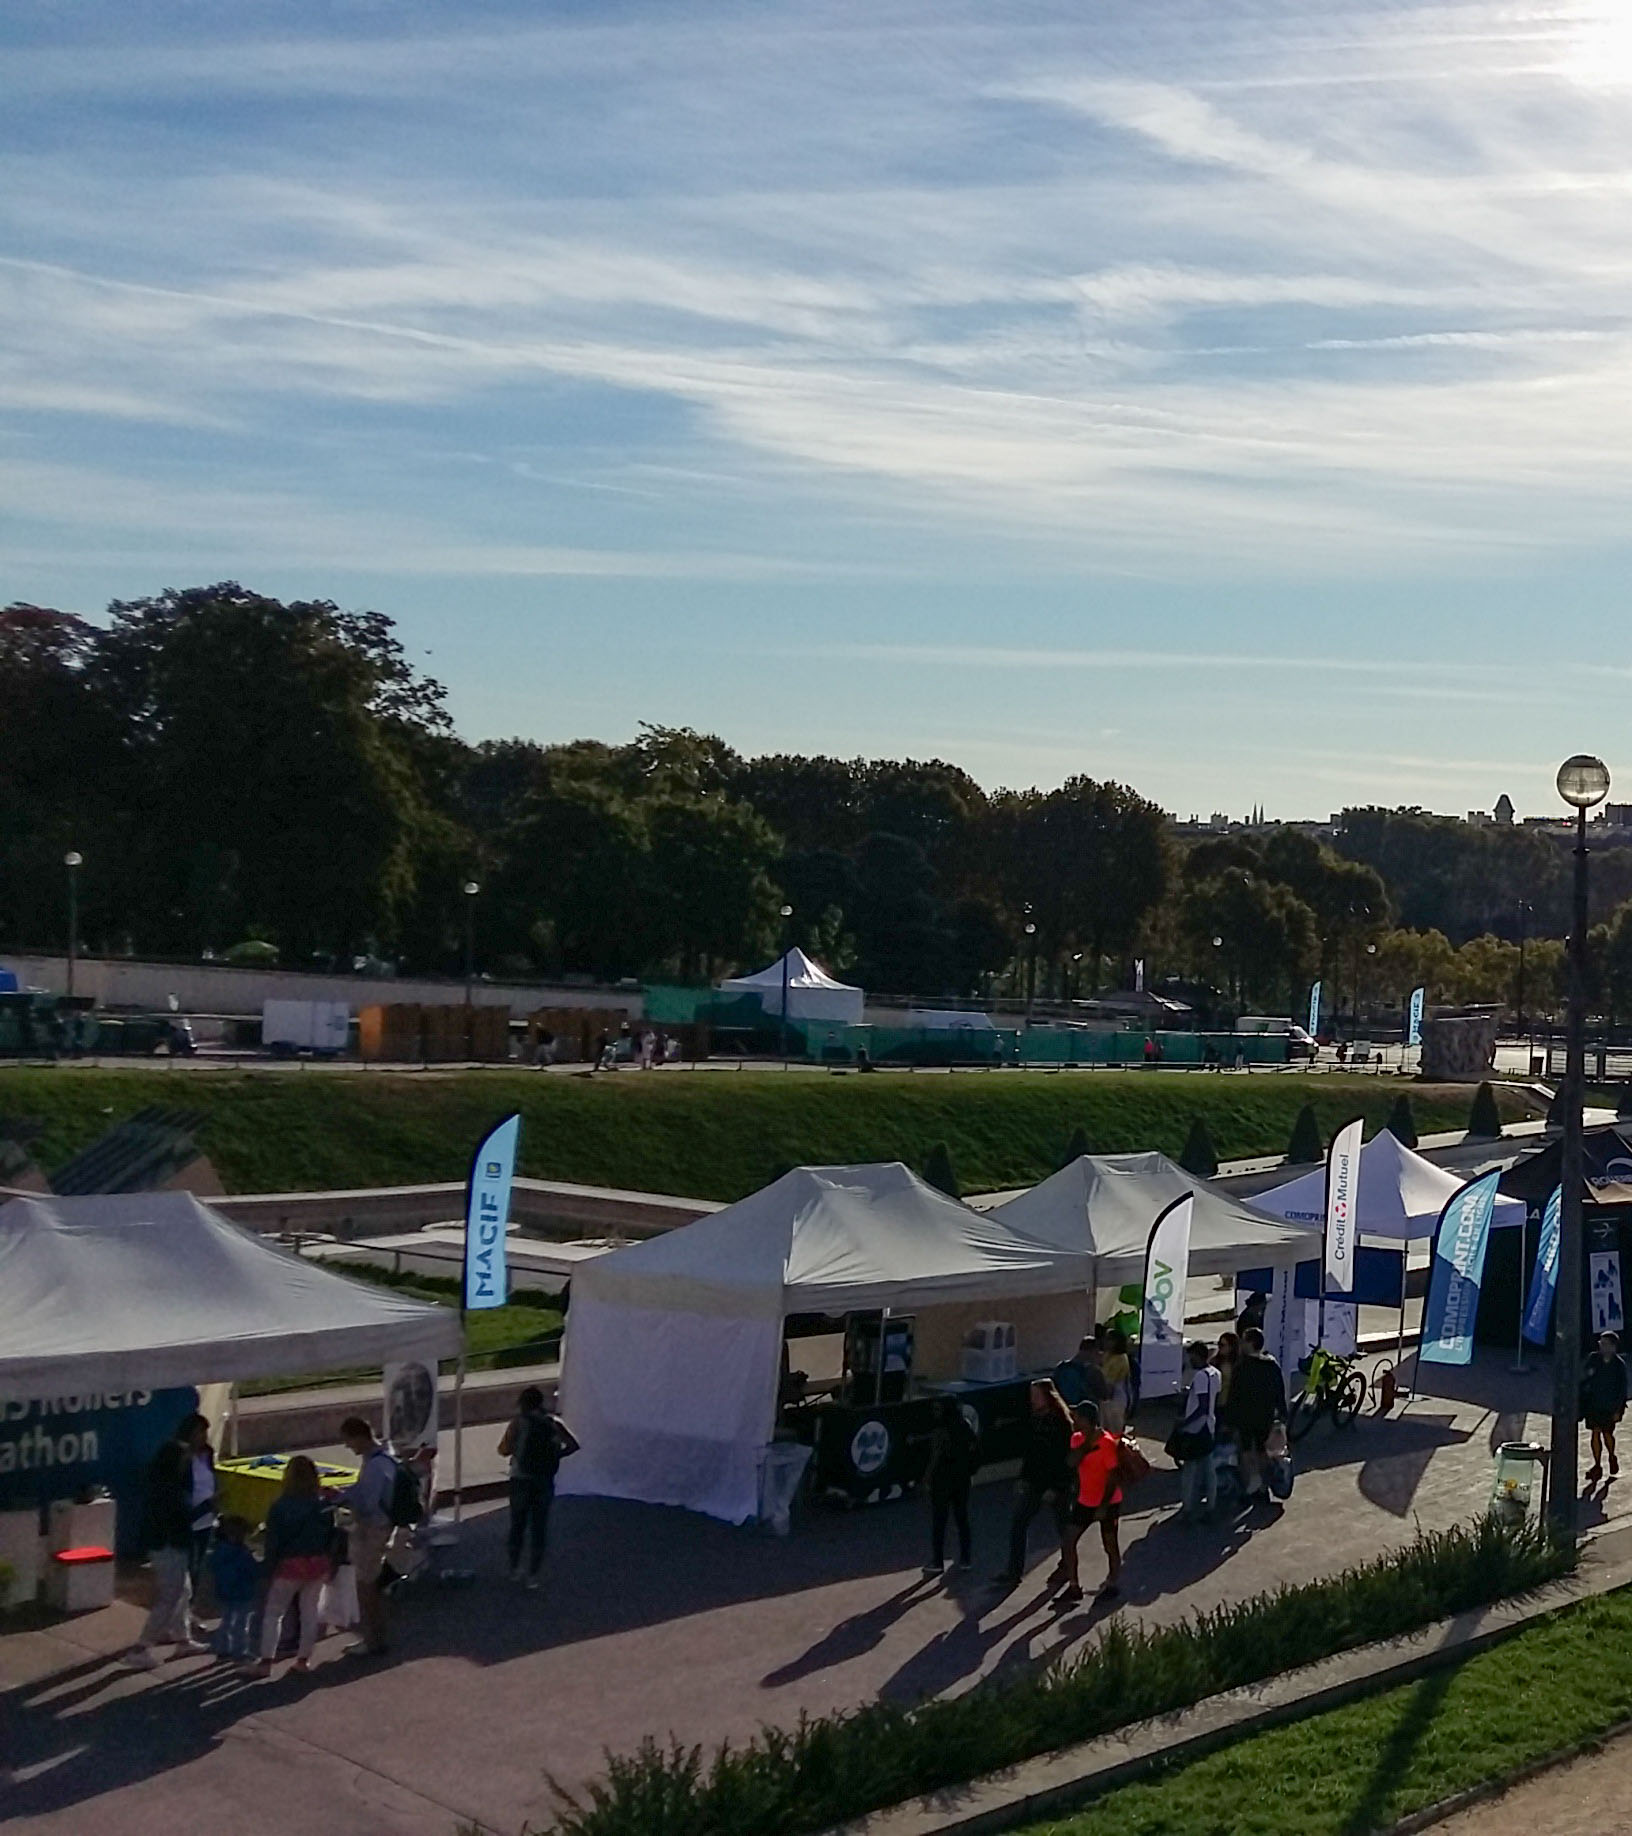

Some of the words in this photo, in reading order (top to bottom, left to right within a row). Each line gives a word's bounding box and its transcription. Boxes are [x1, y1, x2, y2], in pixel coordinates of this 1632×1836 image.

[1337, 1153, 1349, 1201] Mutuel
[475, 1192, 499, 1297] MACIF
[1334, 1218, 1346, 1261] Crédit
[1438, 1193, 1479, 1350] COMOPRINT.COM
